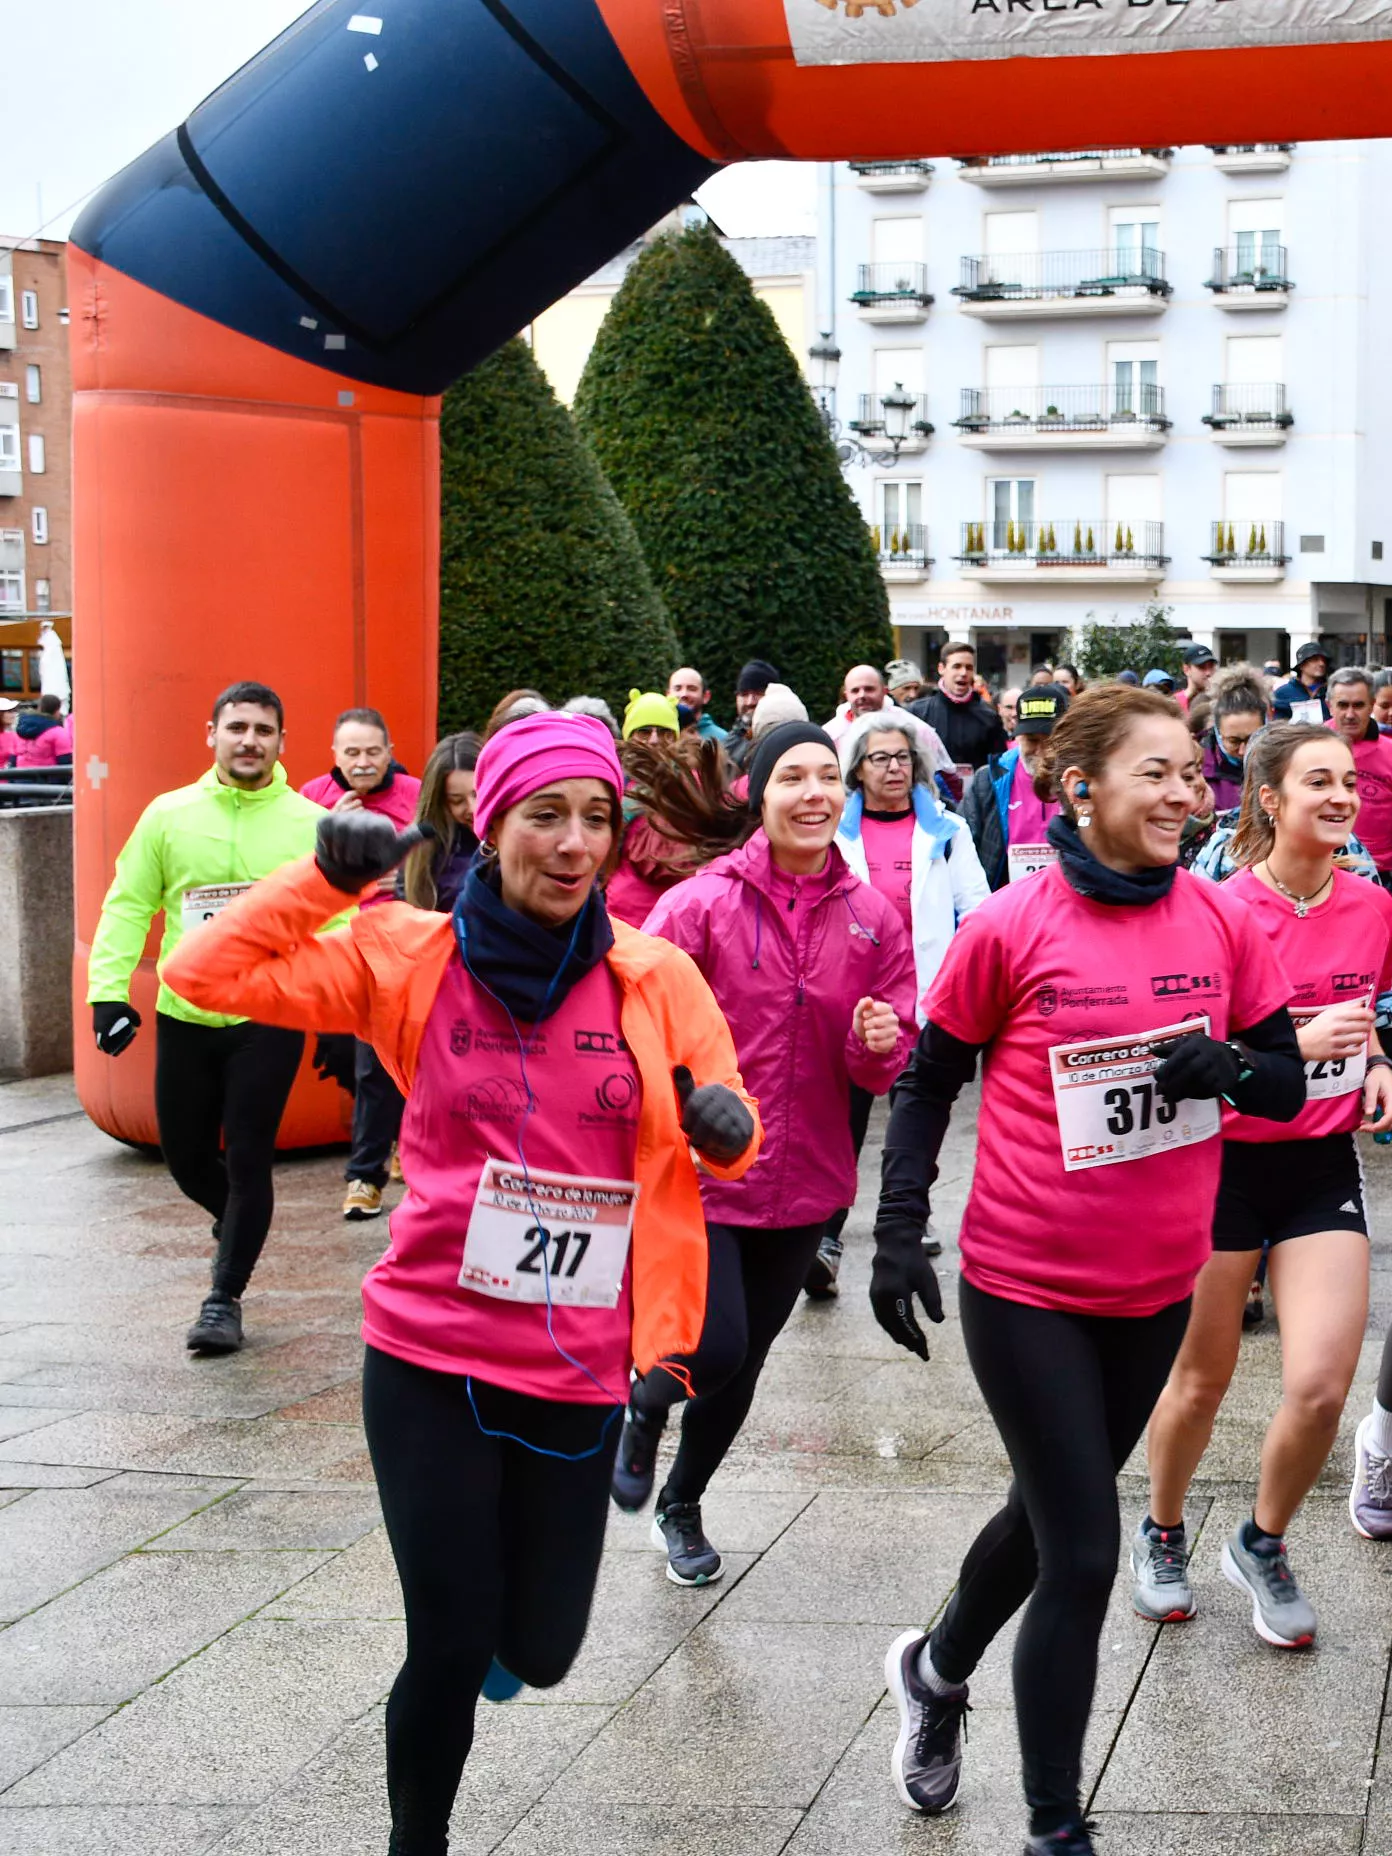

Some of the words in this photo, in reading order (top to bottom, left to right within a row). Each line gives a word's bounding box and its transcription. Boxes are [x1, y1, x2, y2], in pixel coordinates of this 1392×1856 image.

[928, 606, 1014, 620] HONTANAR
[1061, 984, 1128, 998] Ayuntamiento
[1061, 996, 1129, 1010] Ponferrada
[1068, 1048, 1129, 1067] Carrera
[1131, 1044, 1149, 1058] de
[1068, 1073, 1079, 1083] 10
[1082, 1071, 1096, 1081] de
[1099, 1065, 1141, 1079] Marzo
[1104, 1082, 1177, 1136] 373
[500, 1173, 563, 1199] Carrera
[565, 1186, 582, 1201] de
[594, 1191, 628, 1206] mujer
[515, 1226, 592, 1278] 217
